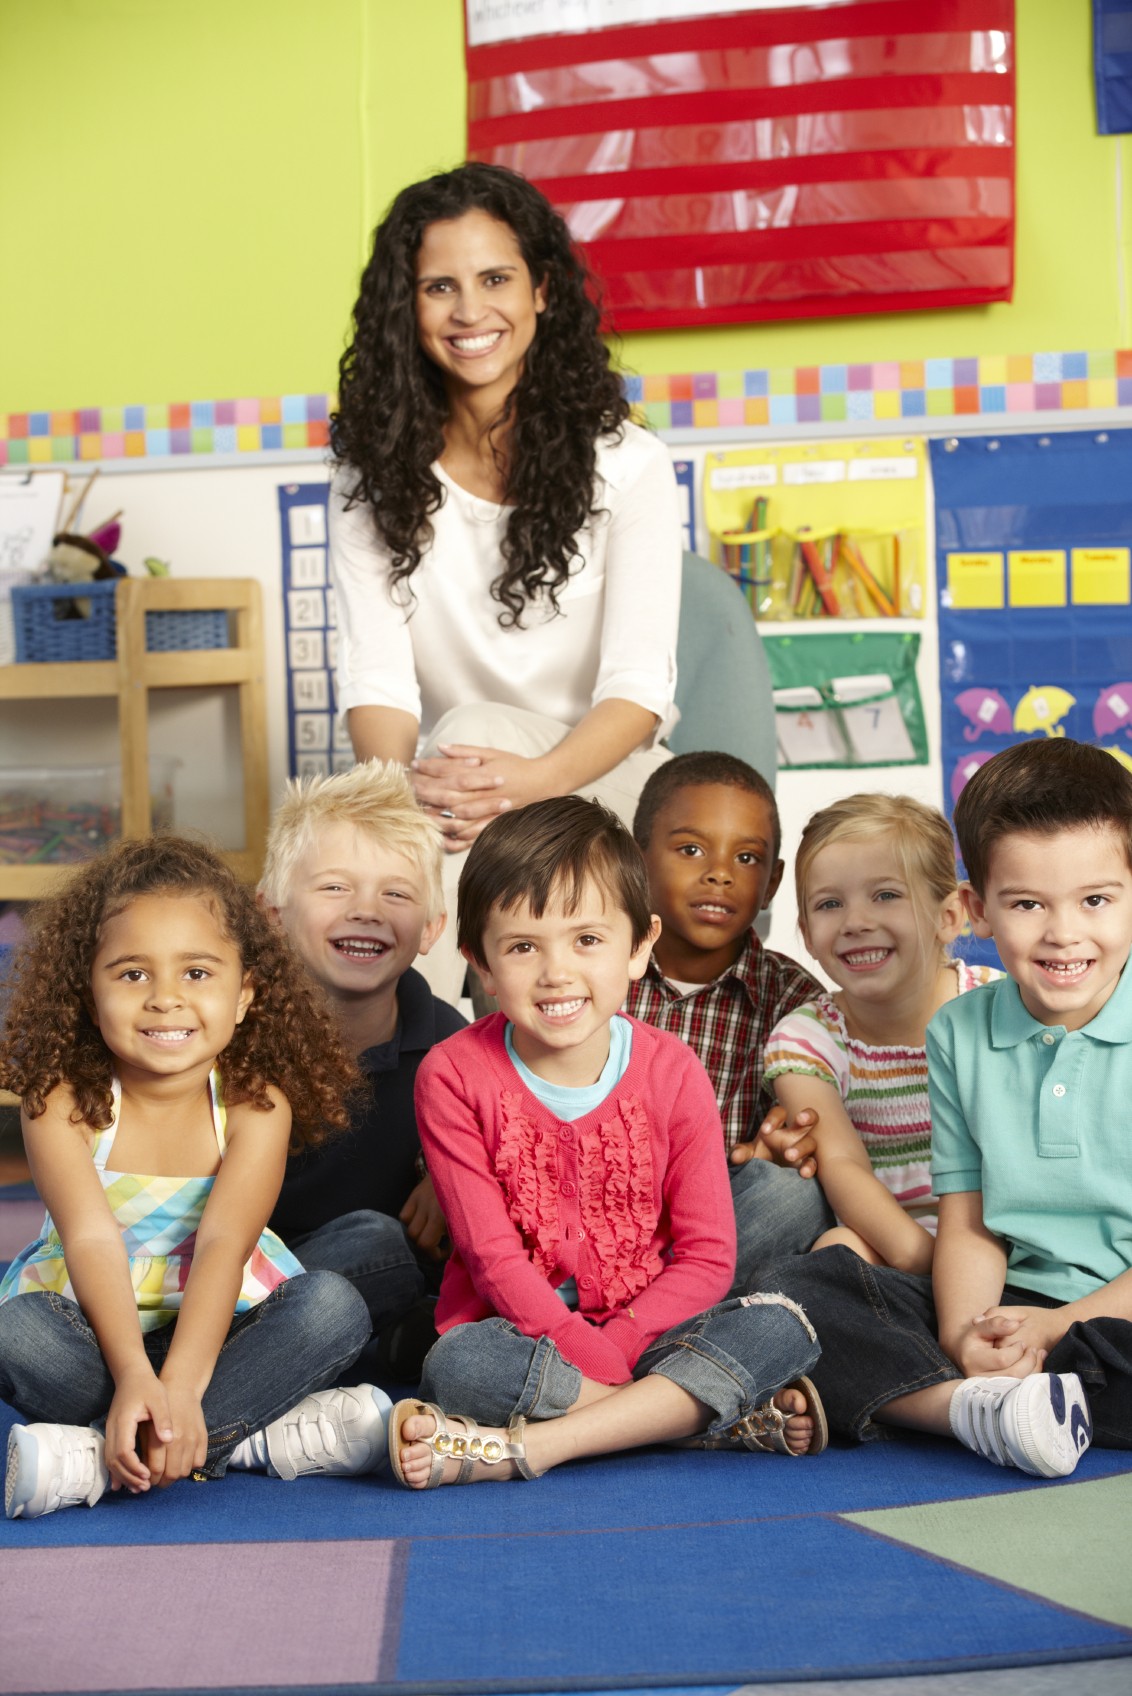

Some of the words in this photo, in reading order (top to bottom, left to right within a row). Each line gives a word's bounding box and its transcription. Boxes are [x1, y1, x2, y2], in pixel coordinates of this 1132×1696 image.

[296, 598, 319, 622] 21
[294, 637, 319, 662] 31
[298, 678, 322, 701] 41
[864, 708, 881, 730] 7
[299, 719, 324, 746] 51
